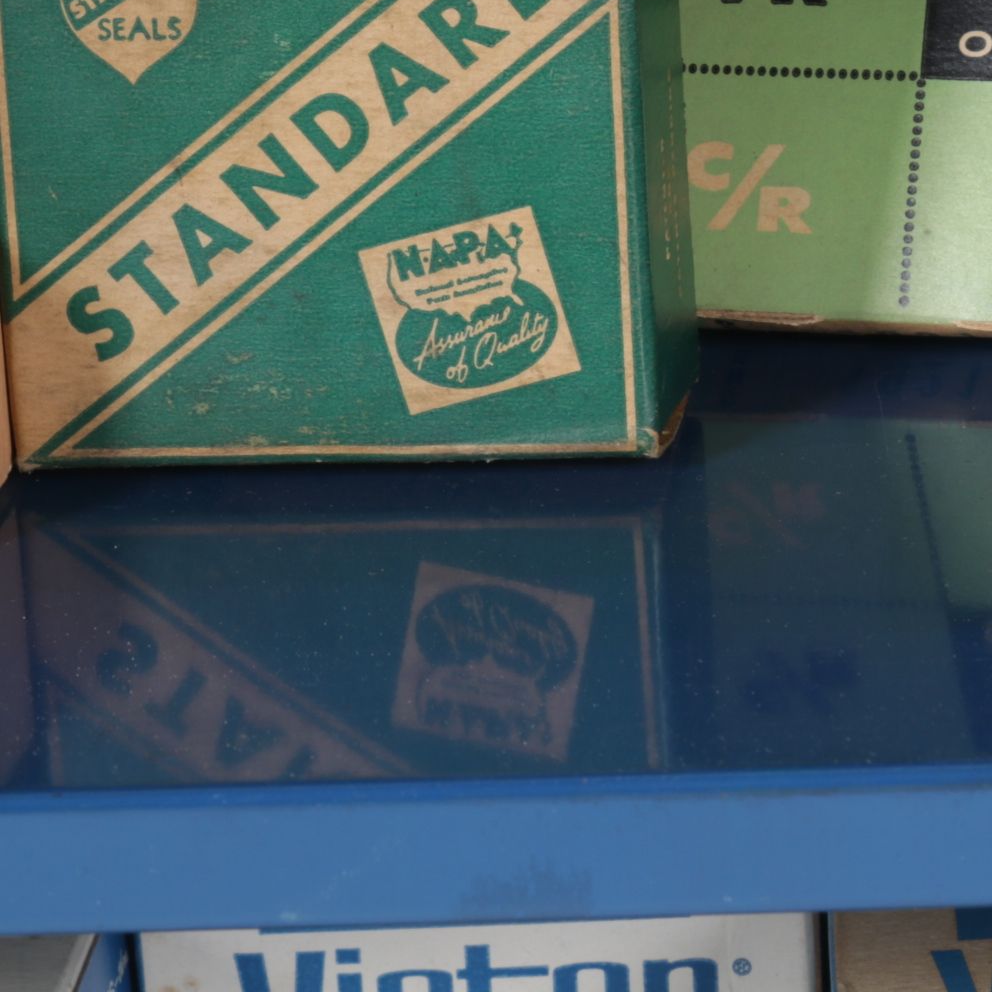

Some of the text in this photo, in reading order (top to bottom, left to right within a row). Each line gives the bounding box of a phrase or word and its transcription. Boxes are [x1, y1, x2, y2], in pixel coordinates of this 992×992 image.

[97, 16, 183, 42] SEALS
[686, 140, 813, 236] C/R
[412, 305, 511, 372] Assurance
[446, 310, 549, 384] of Quality
